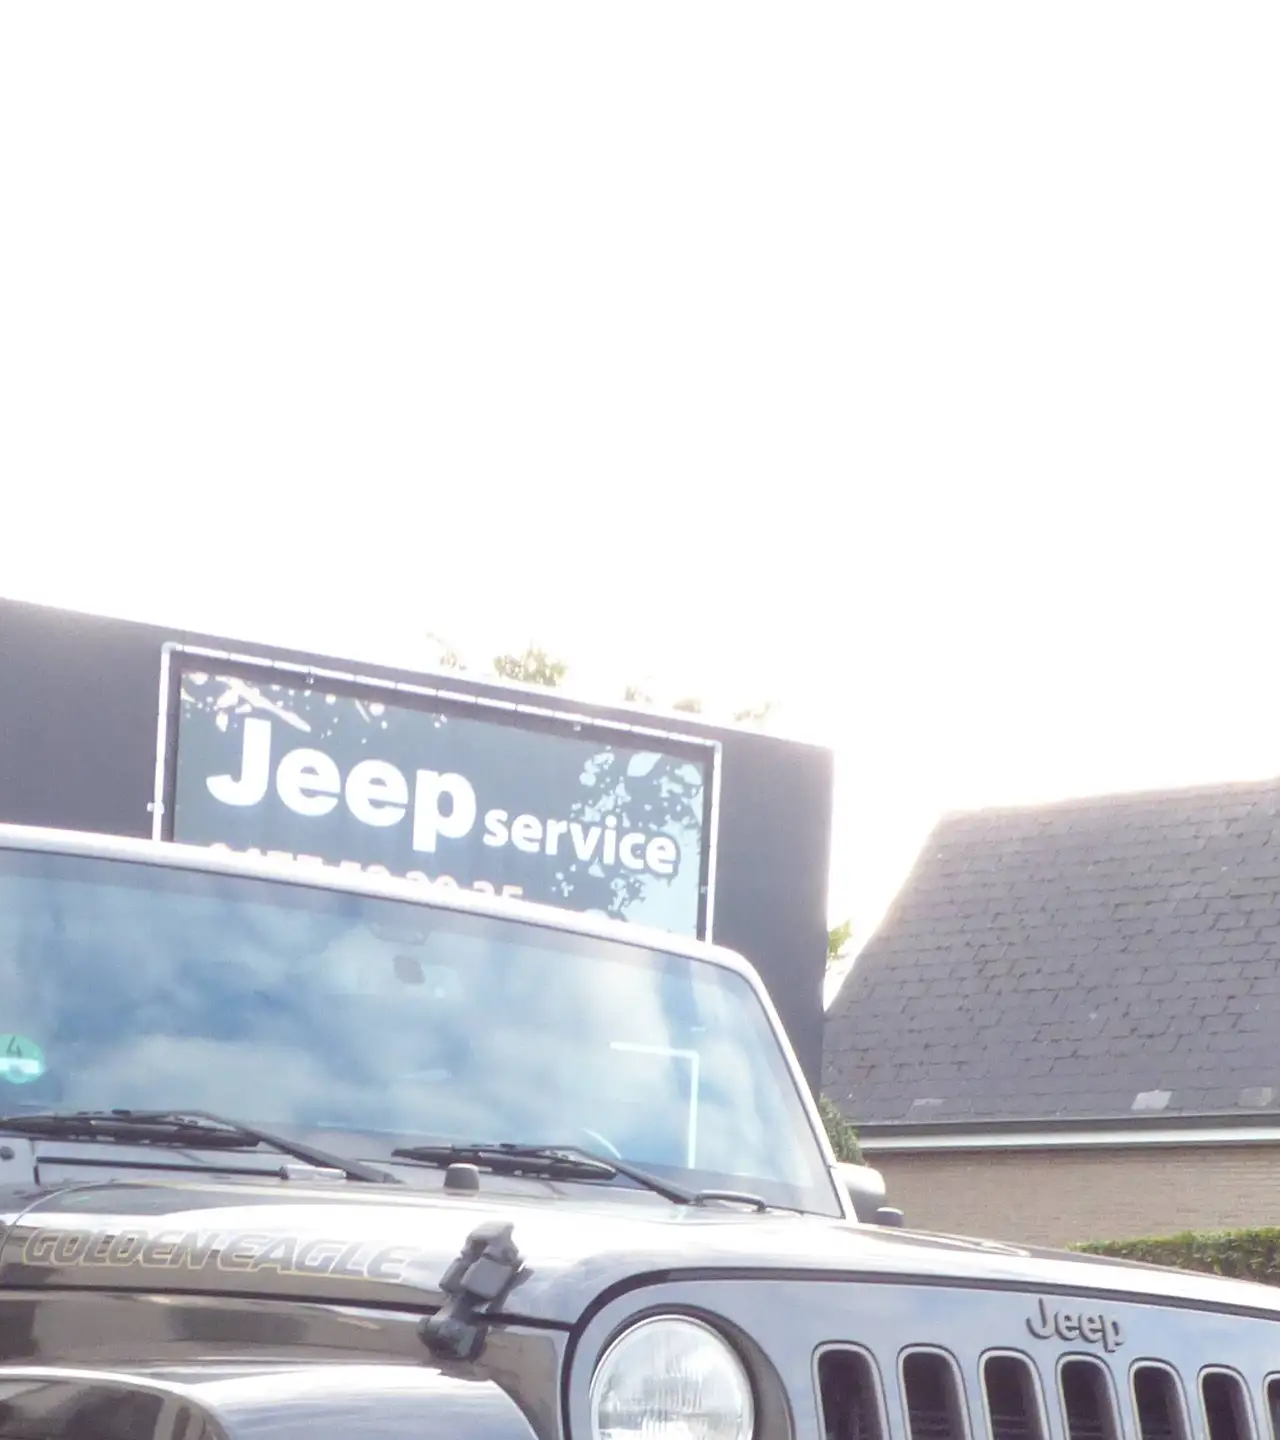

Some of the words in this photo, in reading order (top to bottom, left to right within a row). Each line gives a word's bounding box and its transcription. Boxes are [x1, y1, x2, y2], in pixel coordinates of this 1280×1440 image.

[206, 717, 477, 853] Jeep
[483, 807, 680, 875] service
[6, 1035, 22, 1060] 4
[24, 1228, 221, 1270] GOLDEN
[217, 1232, 418, 1282] EAGLE
[1024, 1296, 1128, 1354] Jeep
